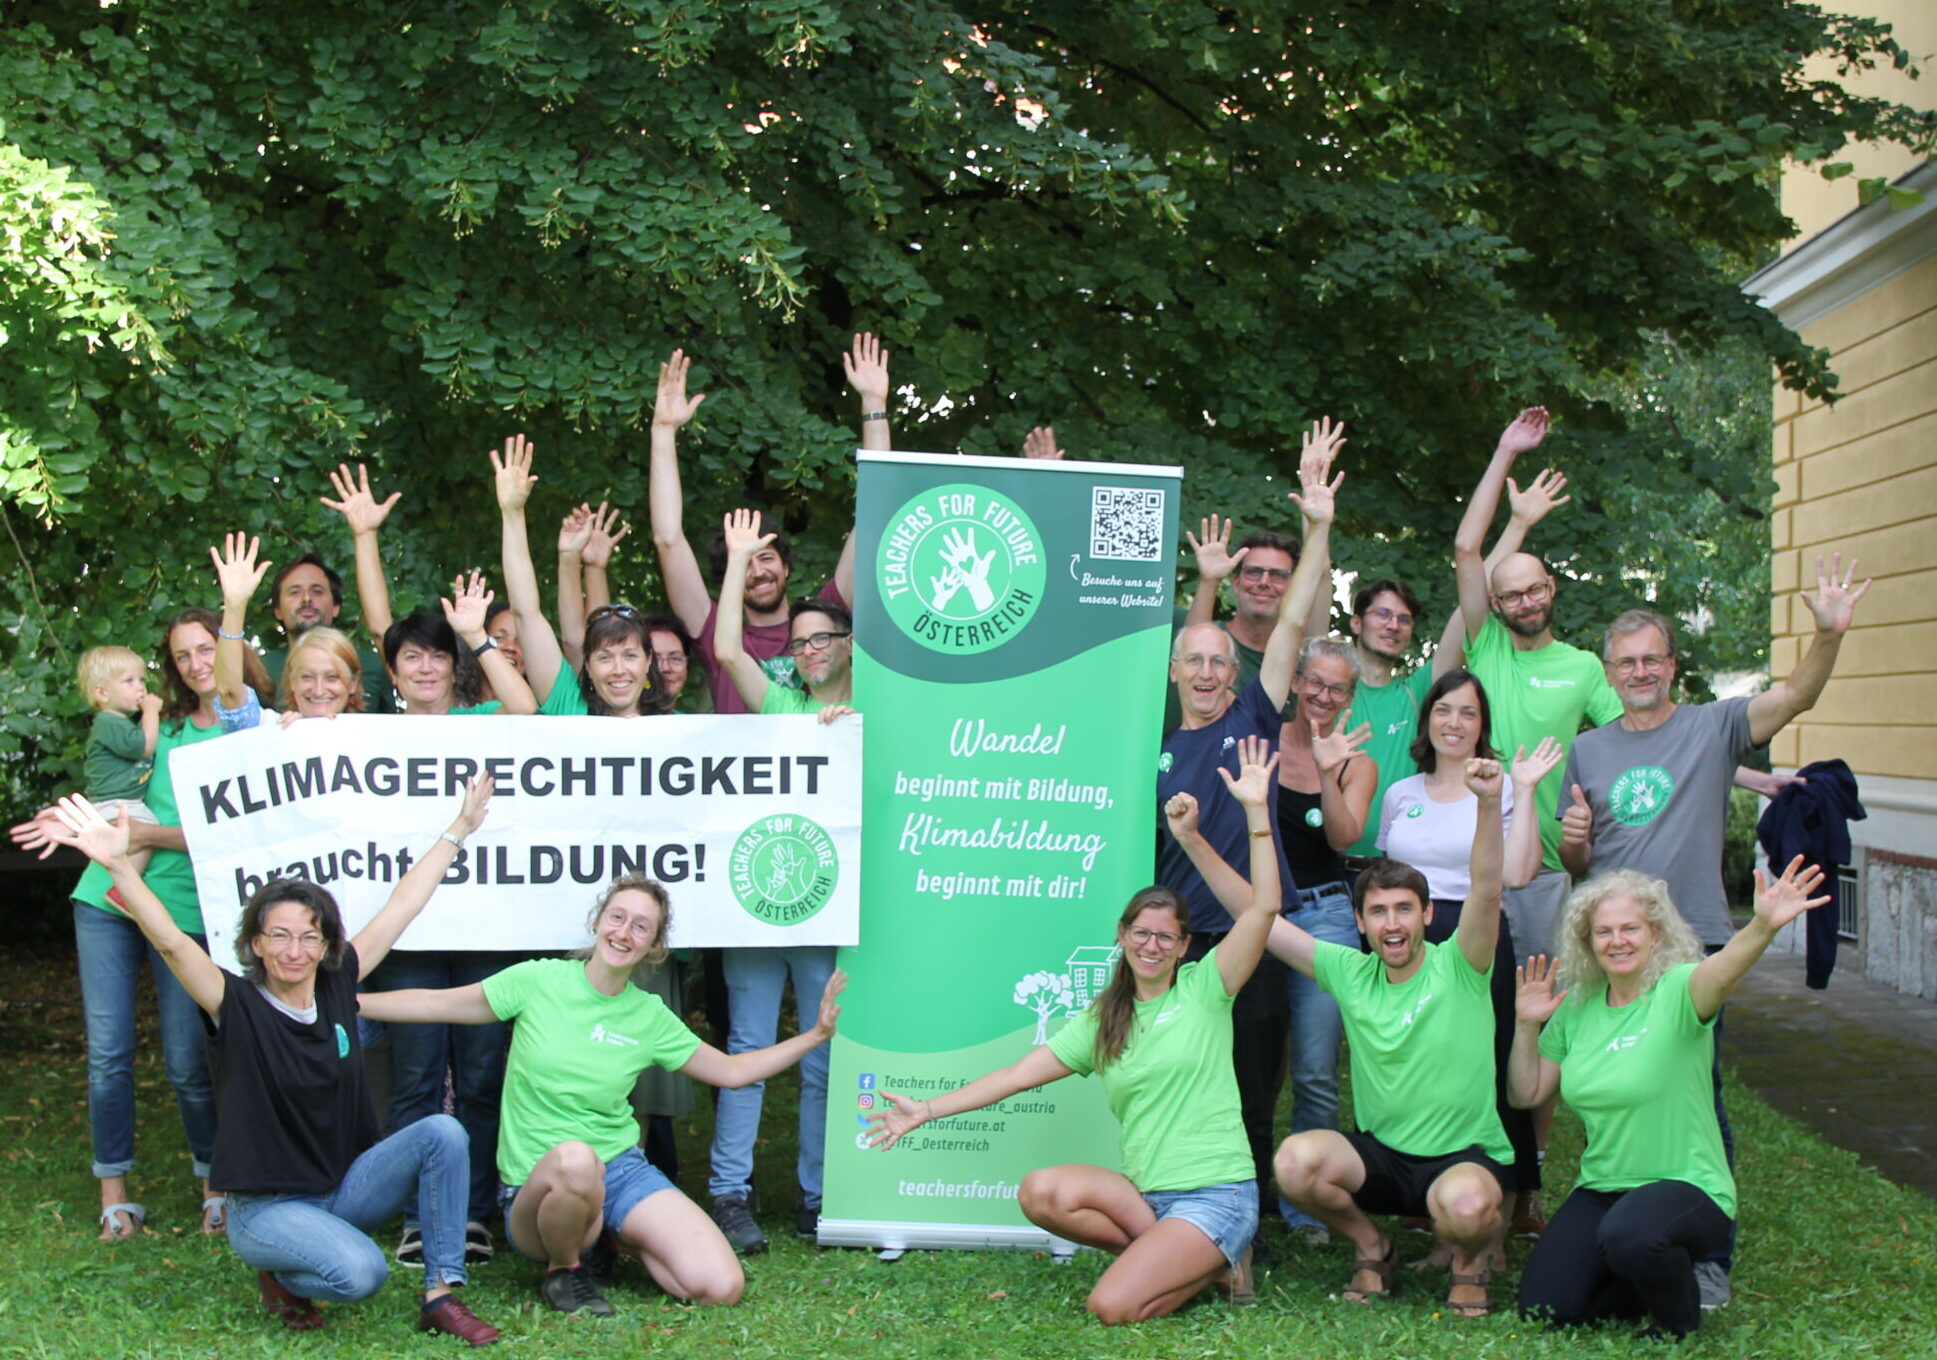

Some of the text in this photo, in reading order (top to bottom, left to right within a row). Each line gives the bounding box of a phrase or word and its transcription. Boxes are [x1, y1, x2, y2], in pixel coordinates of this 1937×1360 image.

[885, 493, 1038, 600] TEACHERS FOR FUTURE
[1079, 593, 1165, 607] unserer Website!
[1081, 572, 1164, 594] Besuche uns auf
[913, 588, 1034, 647] ÖSTERREICH
[950, 718, 1067, 757] Wandel
[200, 755, 829, 824] KLIMAGERECHTIGKEIT
[895, 770, 1114, 810] beginnt mit Bildung,
[733, 818, 835, 900] TEACHERS FOR FUTURE
[898, 812, 1107, 872] Klimabildung
[437, 843, 706, 884] BILDUNG!
[915, 869, 1086, 900] beginnt mit dir!
[884, 1075, 936, 1089] Teachers
[938, 1076, 956, 1090] for
[898, 1178, 1019, 1199] teachersforfut
